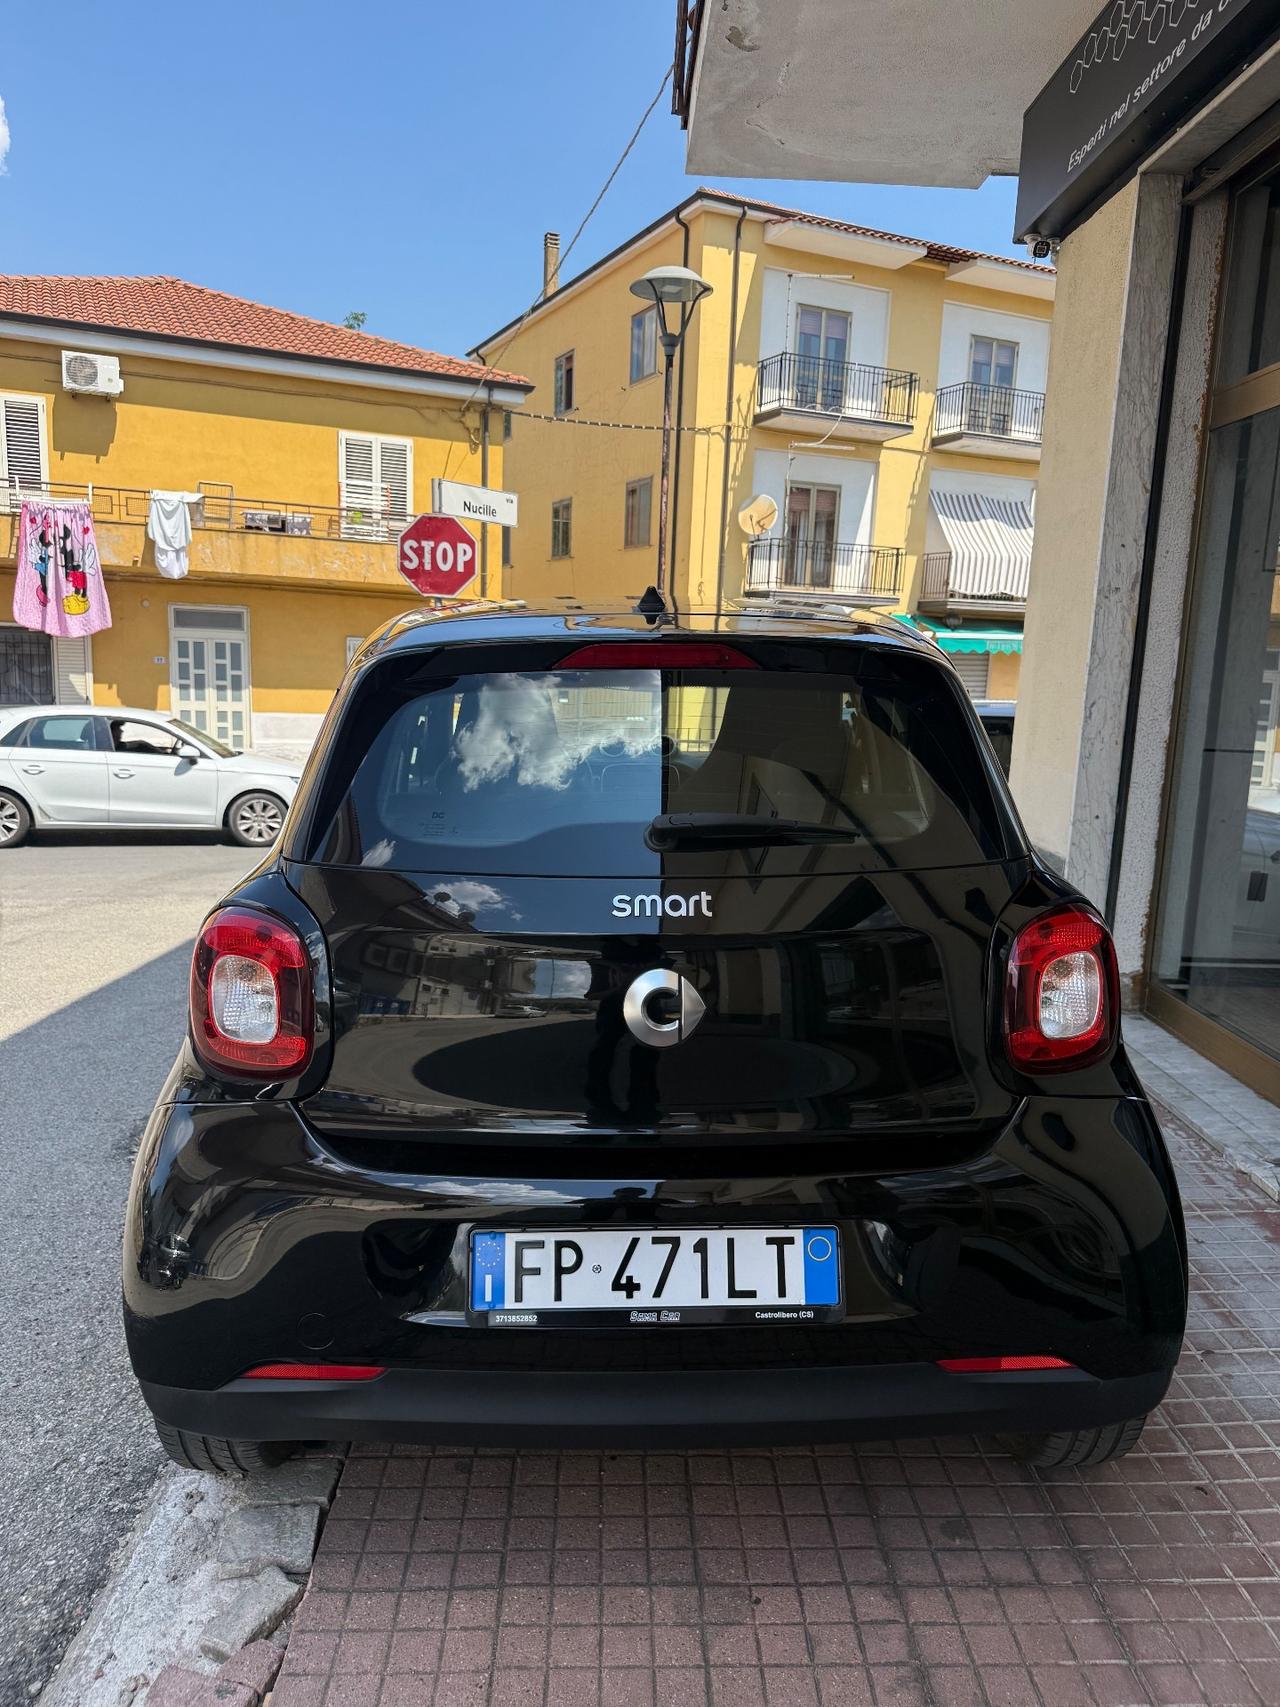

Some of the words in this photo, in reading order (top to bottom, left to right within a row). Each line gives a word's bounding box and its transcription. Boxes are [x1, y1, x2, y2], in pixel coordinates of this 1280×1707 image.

[1066, 118, 1108, 173] Esperti
[1109, 93, 1131, 129] nel
[1132, 38, 1187, 103] settore
[1191, 8, 1214, 41] da
[463, 501, 497, 517] Nucille
[402, 539, 473, 573] STOP
[611, 891, 713, 918] smart
[514, 1239, 584, 1303] FP
[611, 1236, 796, 1300] 471LT
[755, 1311, 798, 1319] Castrolibero
[799, 1310, 814, 1320] (CS)
